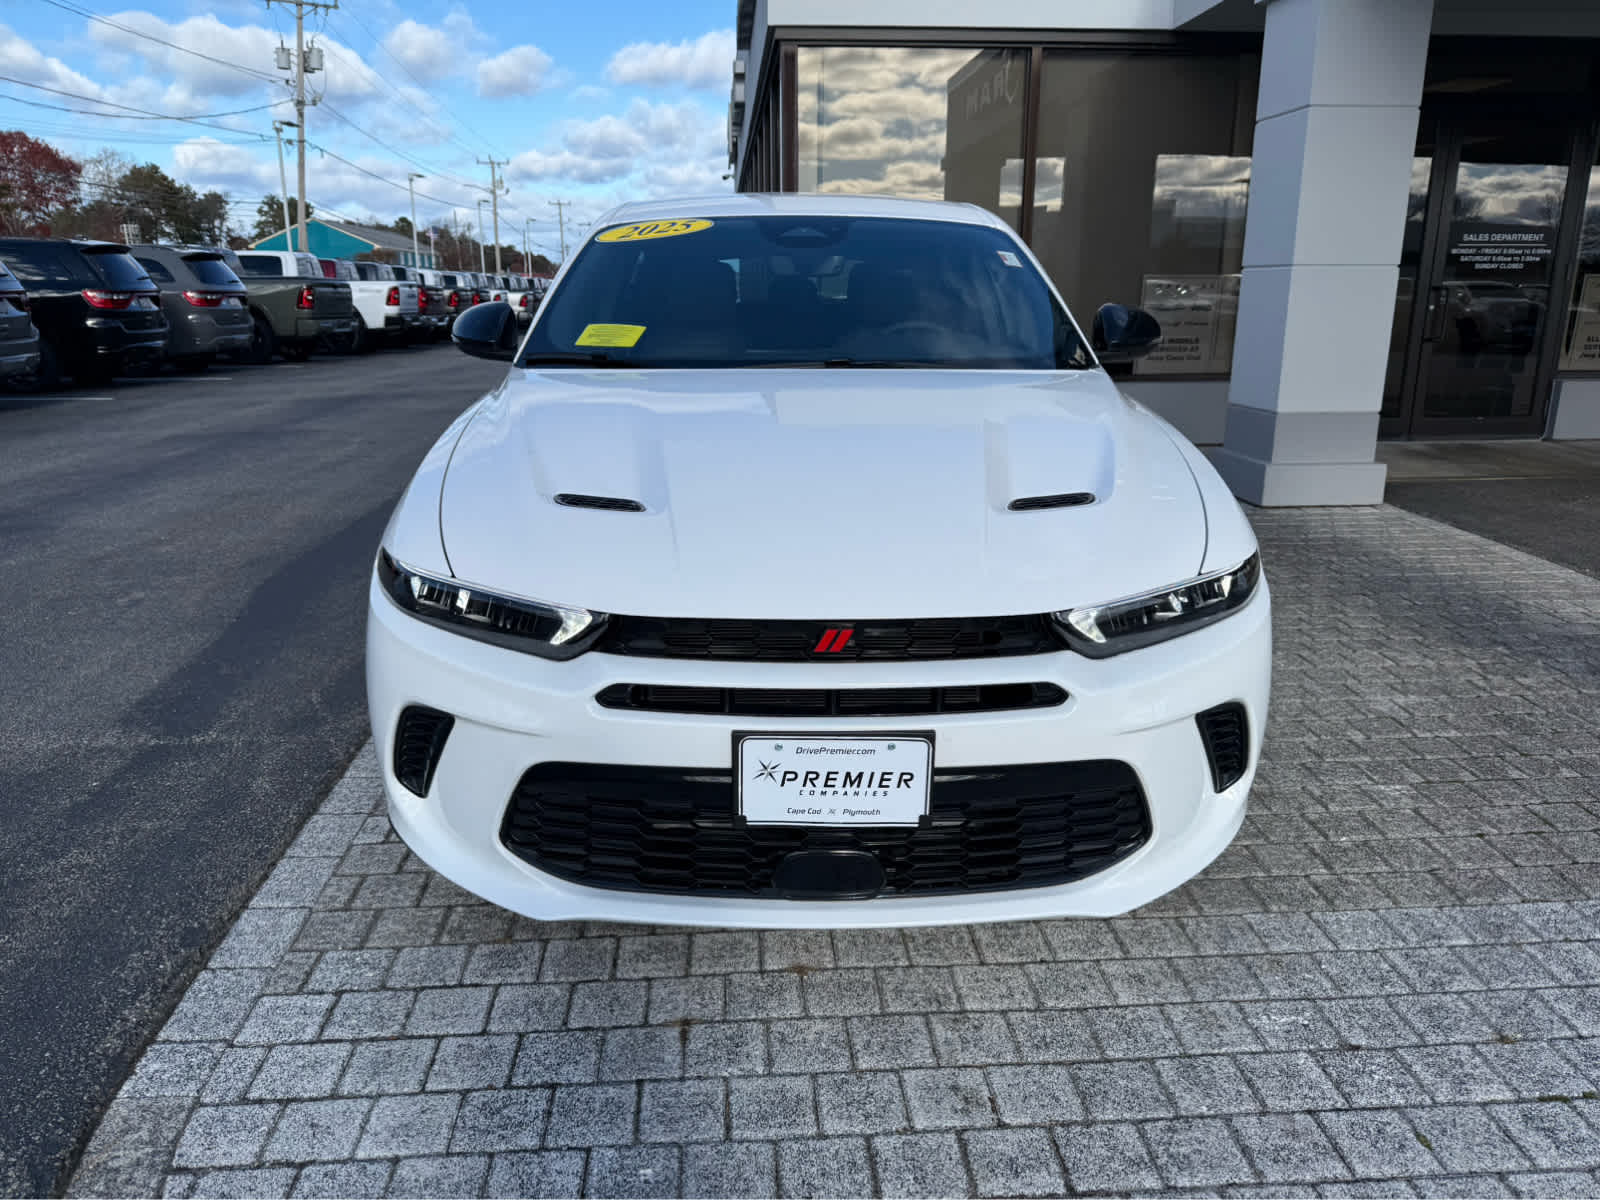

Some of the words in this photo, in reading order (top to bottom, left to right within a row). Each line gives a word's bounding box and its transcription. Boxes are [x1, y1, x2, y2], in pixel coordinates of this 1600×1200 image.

[616, 220, 698, 239] 2025
[1463, 233, 1489, 241] SALES
[1491, 233, 1545, 241] DEPARTMENT
[795, 746, 876, 755] DrivePremier.com
[780, 770, 915, 789] PREMIER
[787, 807, 806, 816] Cape
[807, 807, 822, 815] Cod
[842, 808, 881, 817] Plymouth
